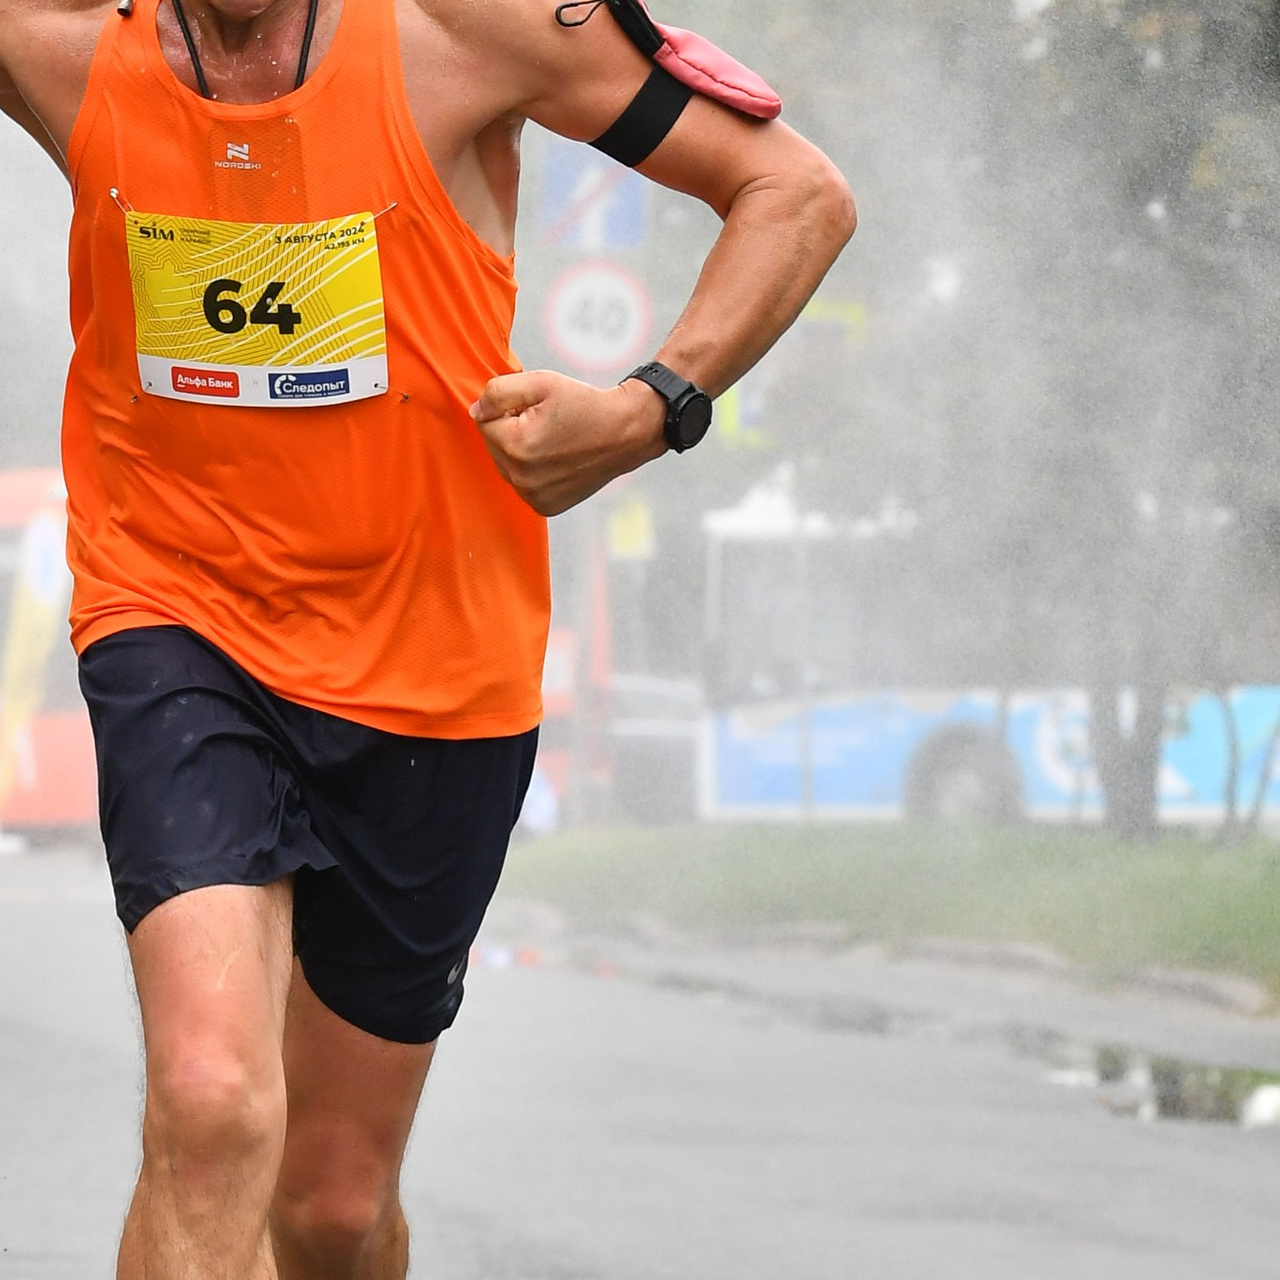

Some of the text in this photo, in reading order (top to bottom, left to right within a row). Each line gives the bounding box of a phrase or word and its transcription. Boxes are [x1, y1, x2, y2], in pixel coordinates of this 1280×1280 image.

[214, 161, 261, 170] NORDSKI
[275, 225, 365, 245] 3 АВГУСТА 2024
[351, 236, 365, 245] КМ
[203, 279, 302, 335] 64
[567, 291, 631, 339] 40
[177, 373, 234, 389] Альфа Банк
[282, 380, 346, 394] Следопыт
